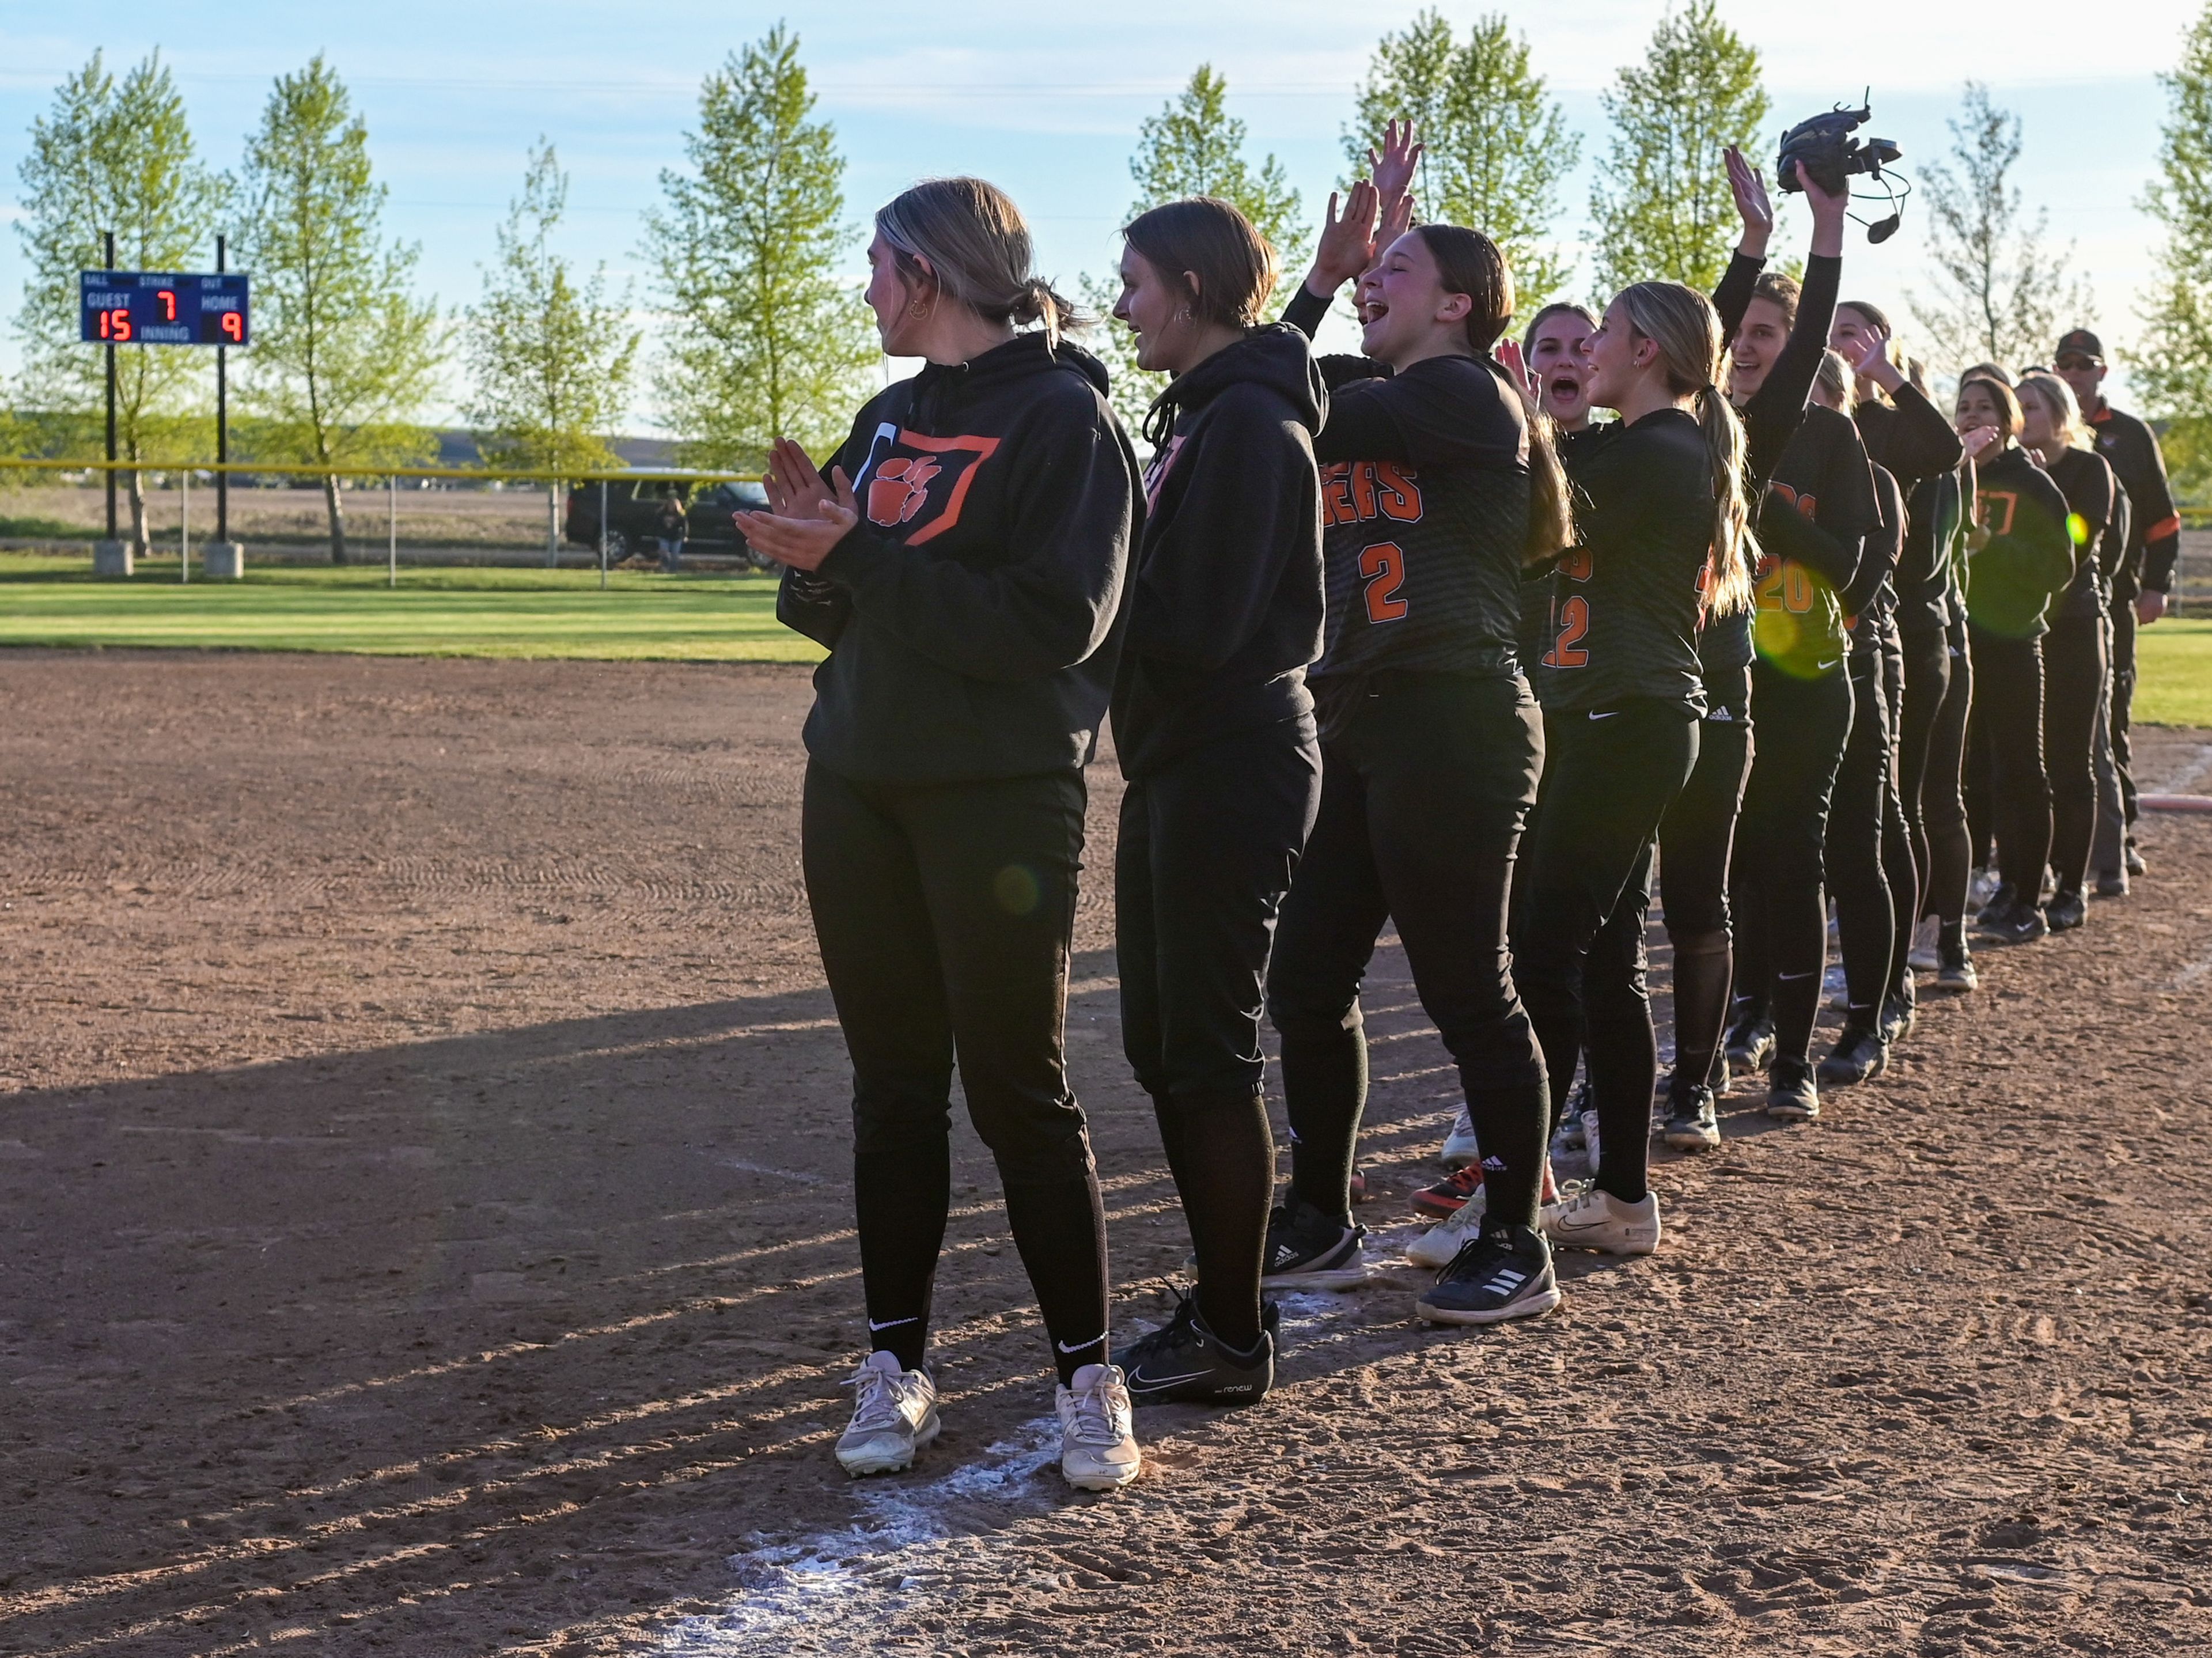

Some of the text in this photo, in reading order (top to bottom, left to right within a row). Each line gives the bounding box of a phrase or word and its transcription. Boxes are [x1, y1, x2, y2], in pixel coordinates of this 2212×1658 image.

[200, 277, 222, 290] OUT
[87, 292, 130, 308] GUEST
[157, 290, 176, 321] 7
[201, 296, 238, 310] HOME
[100, 308, 132, 341] 15
[140, 324, 190, 341] INNING
[221, 312, 243, 342] 9
[1358, 541, 1408, 624] 2
[1752, 552, 1814, 613] 20
[1274, 1251, 1299, 1267] adidas
